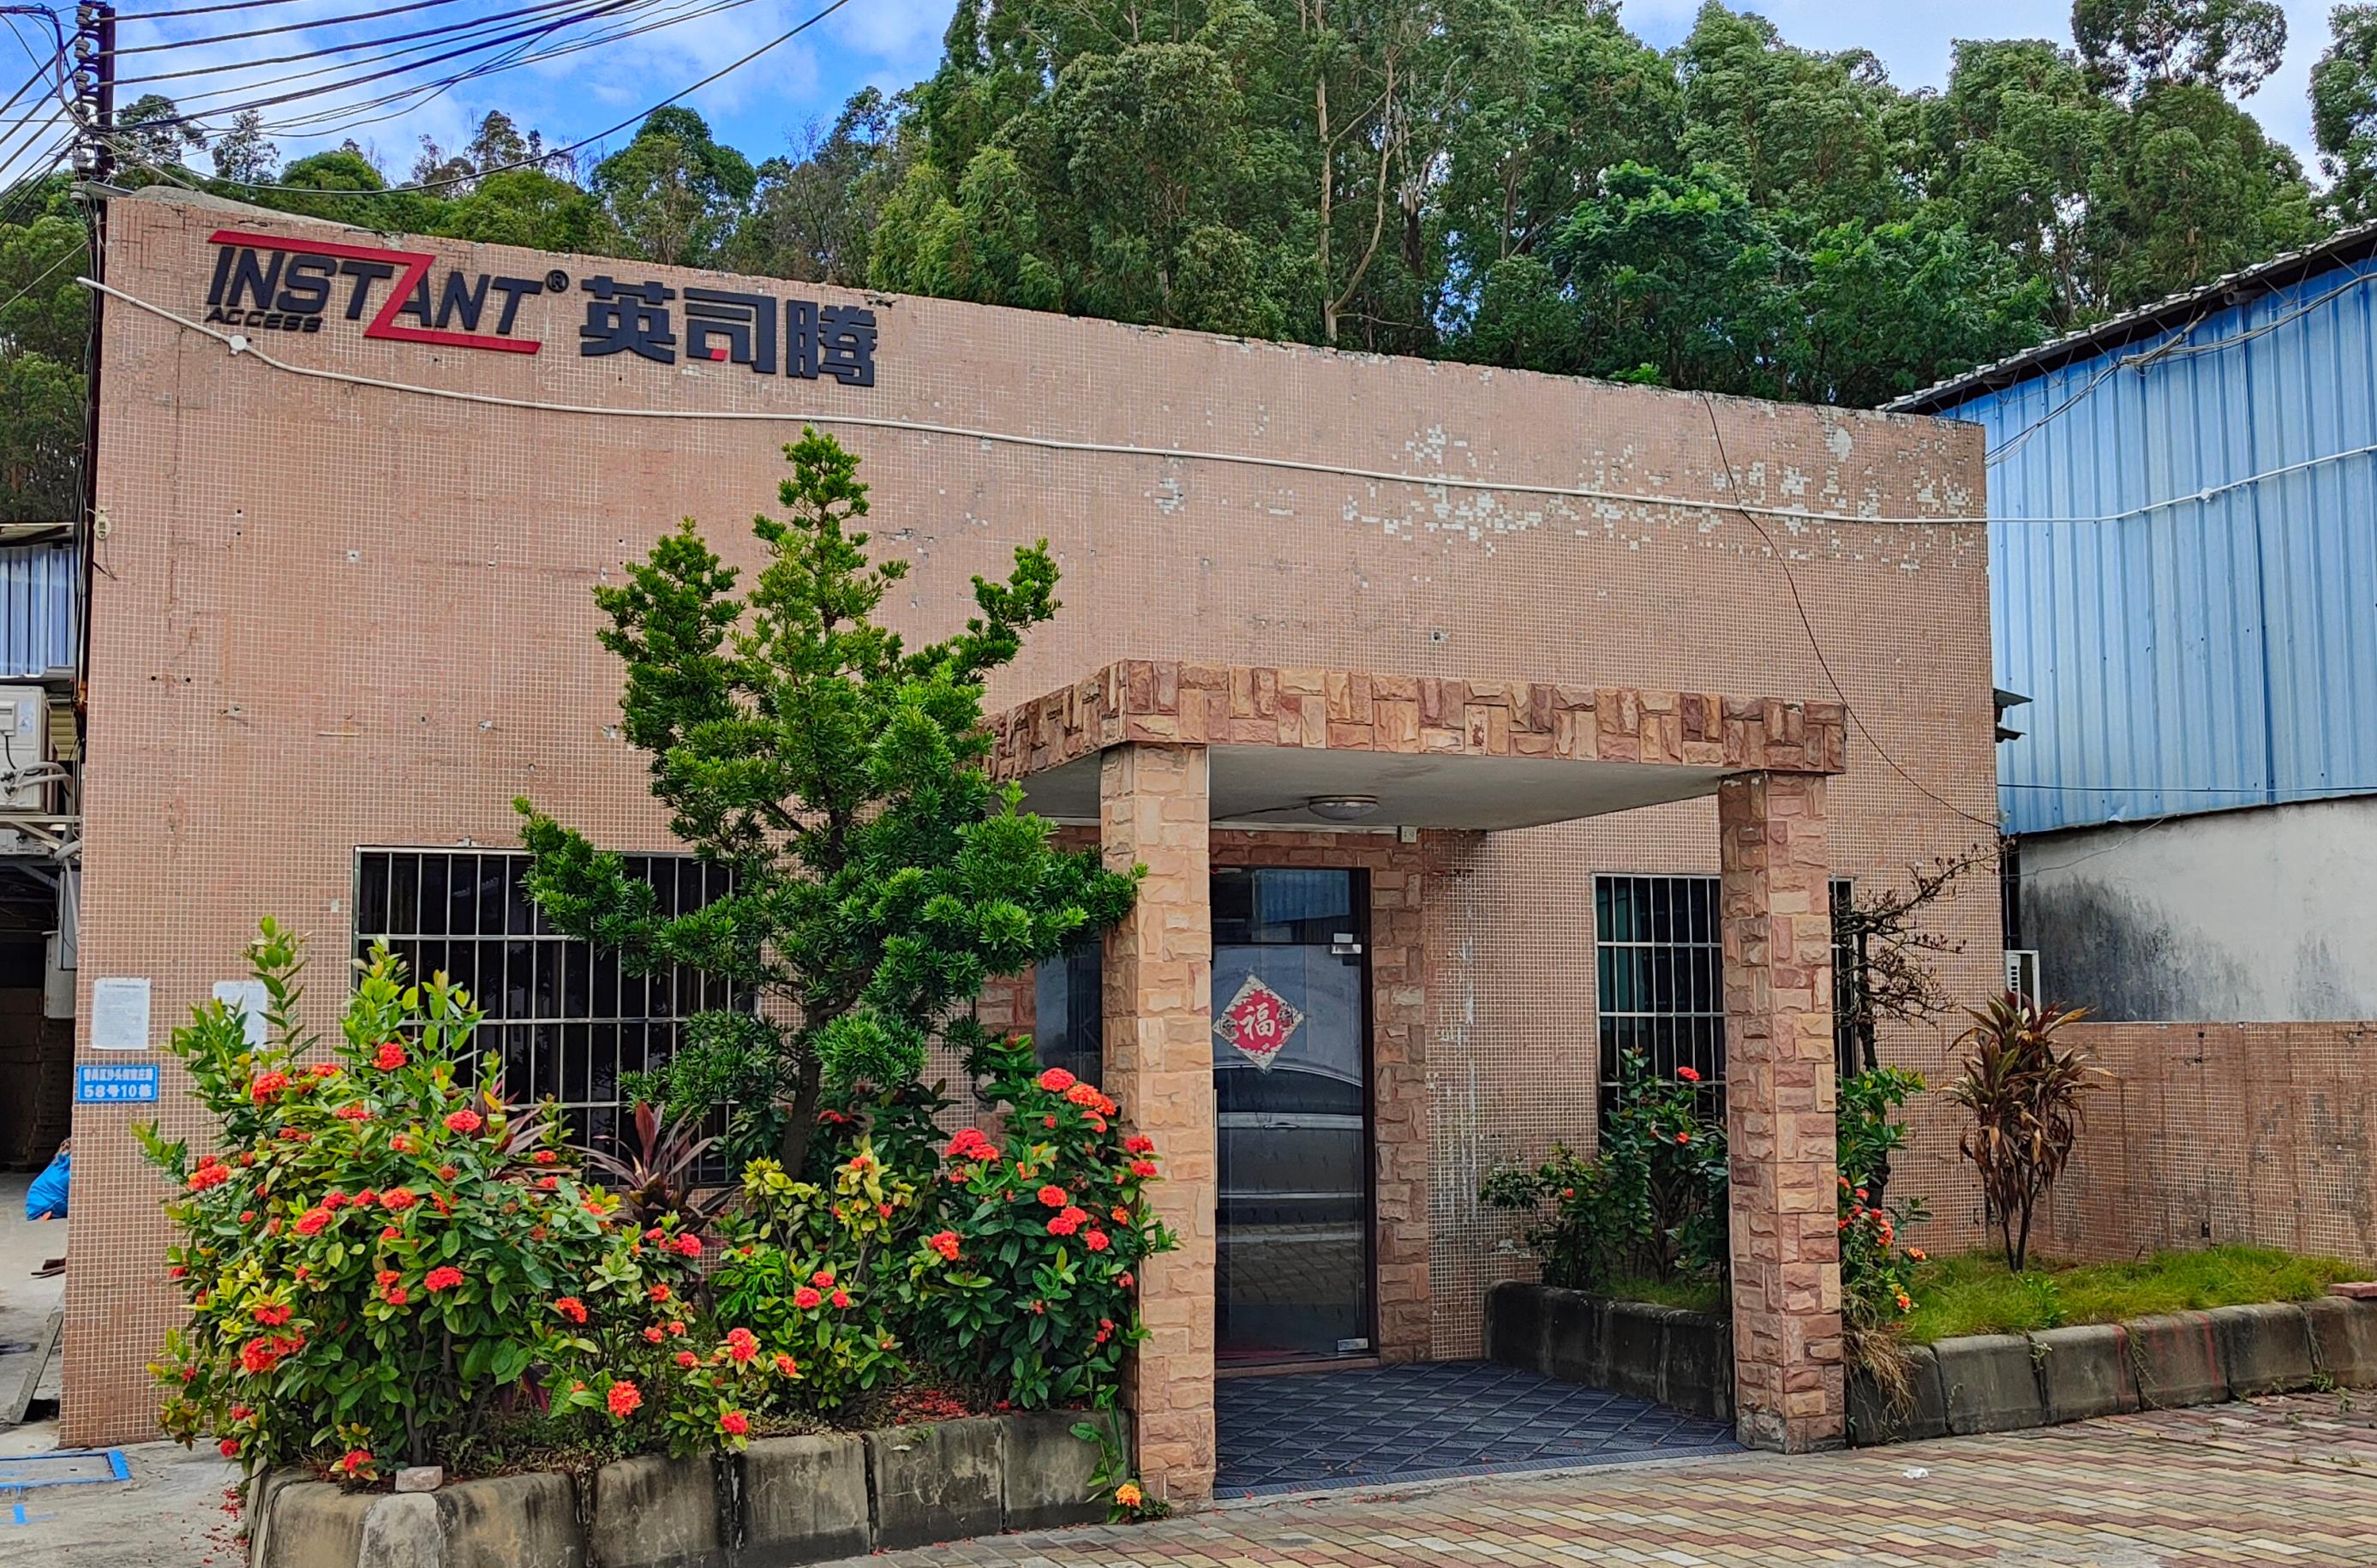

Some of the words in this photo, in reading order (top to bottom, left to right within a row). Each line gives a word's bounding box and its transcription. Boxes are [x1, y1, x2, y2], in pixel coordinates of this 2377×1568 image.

[205, 306, 323, 333] ACCESS
[580, 274, 877, 388] 英司腾
[1240, 1002, 1277, 1041] 福
